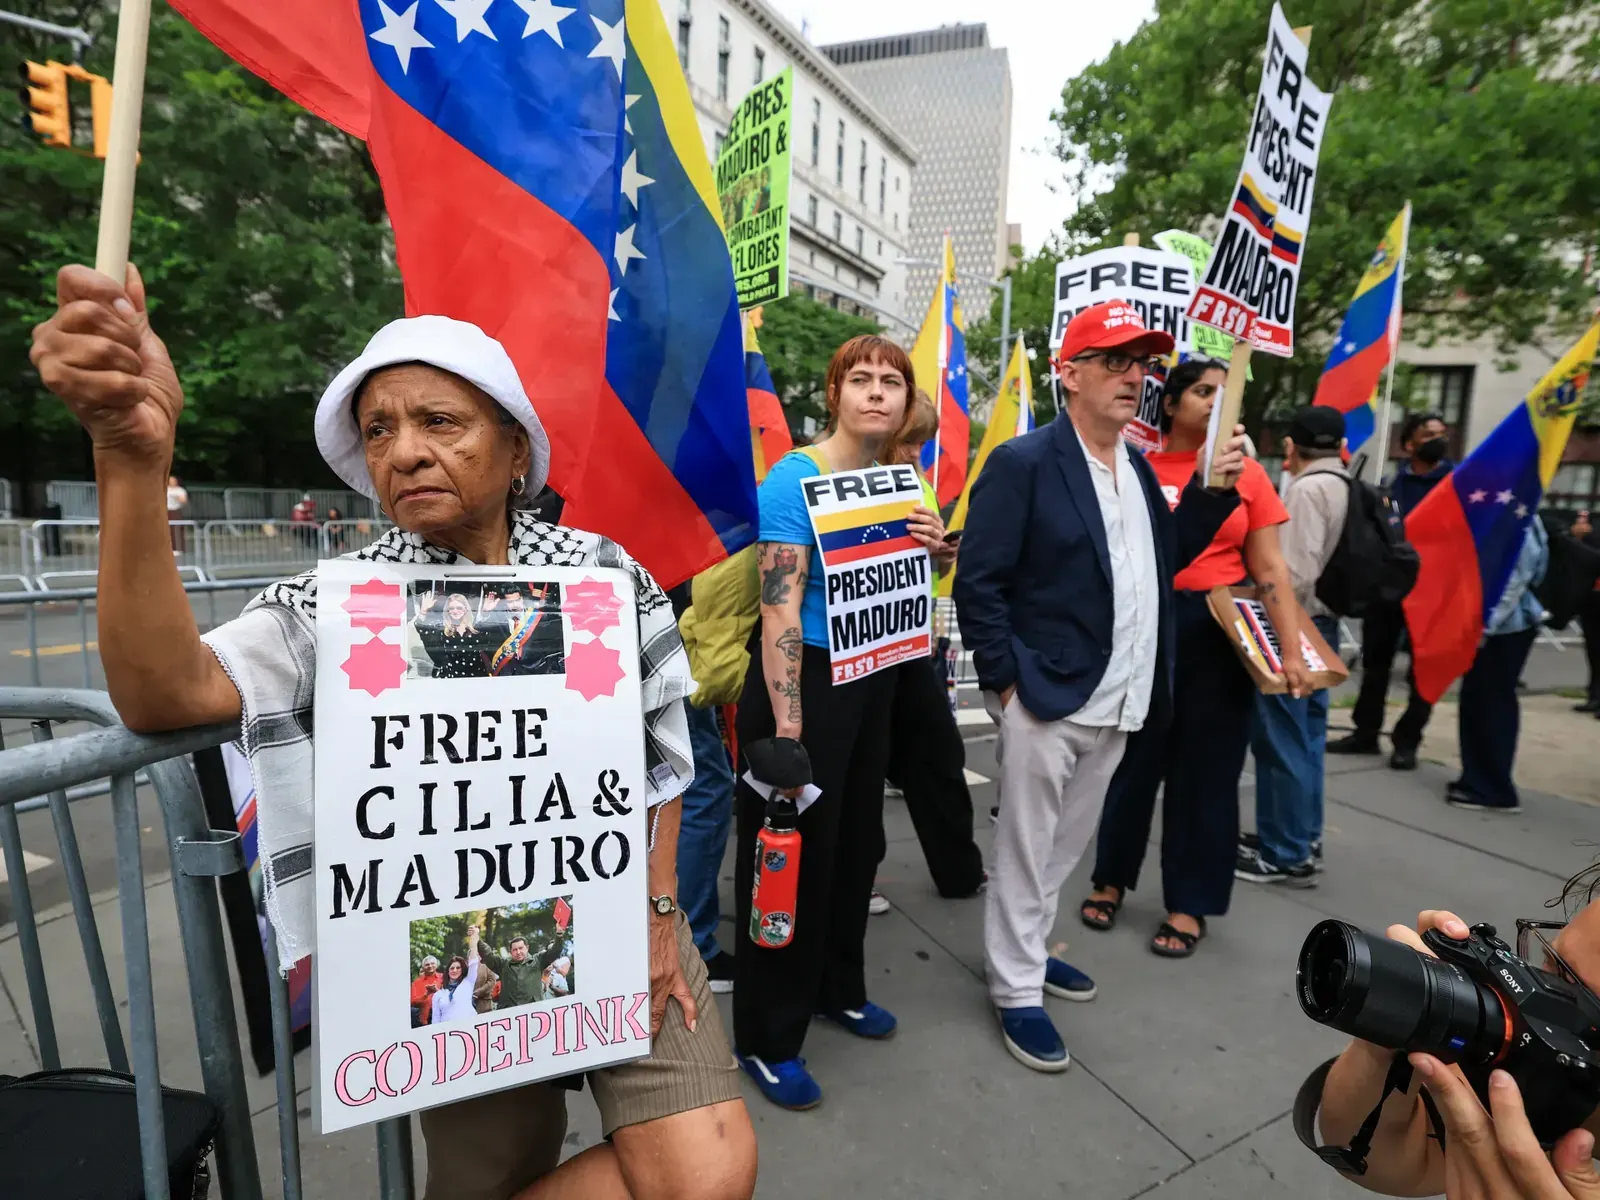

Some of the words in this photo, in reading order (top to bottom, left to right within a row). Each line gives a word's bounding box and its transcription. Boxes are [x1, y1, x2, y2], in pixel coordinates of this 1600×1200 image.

[742, 77, 788, 134] PRES.
[1265, 29, 1319, 151] FRE
[717, 128, 771, 194] MADURO
[776, 120, 787, 156] &
[735, 232, 780, 275] FLORES
[1059, 261, 1191, 301] FREE
[1204, 217, 1294, 325] MADRO
[803, 469, 919, 508] FREE
[827, 554, 927, 606] PRESIDENT
[830, 594, 928, 653] MADURO
[833, 655, 874, 682] FRSO
[369, 707, 548, 770] FREE
[355, 771, 577, 840] CILIA
[592, 768, 633, 818] &
[329, 830, 632, 920] MADURO
[1499, 968, 1524, 994] SONY
[334, 991, 650, 1107] CODEPINK
